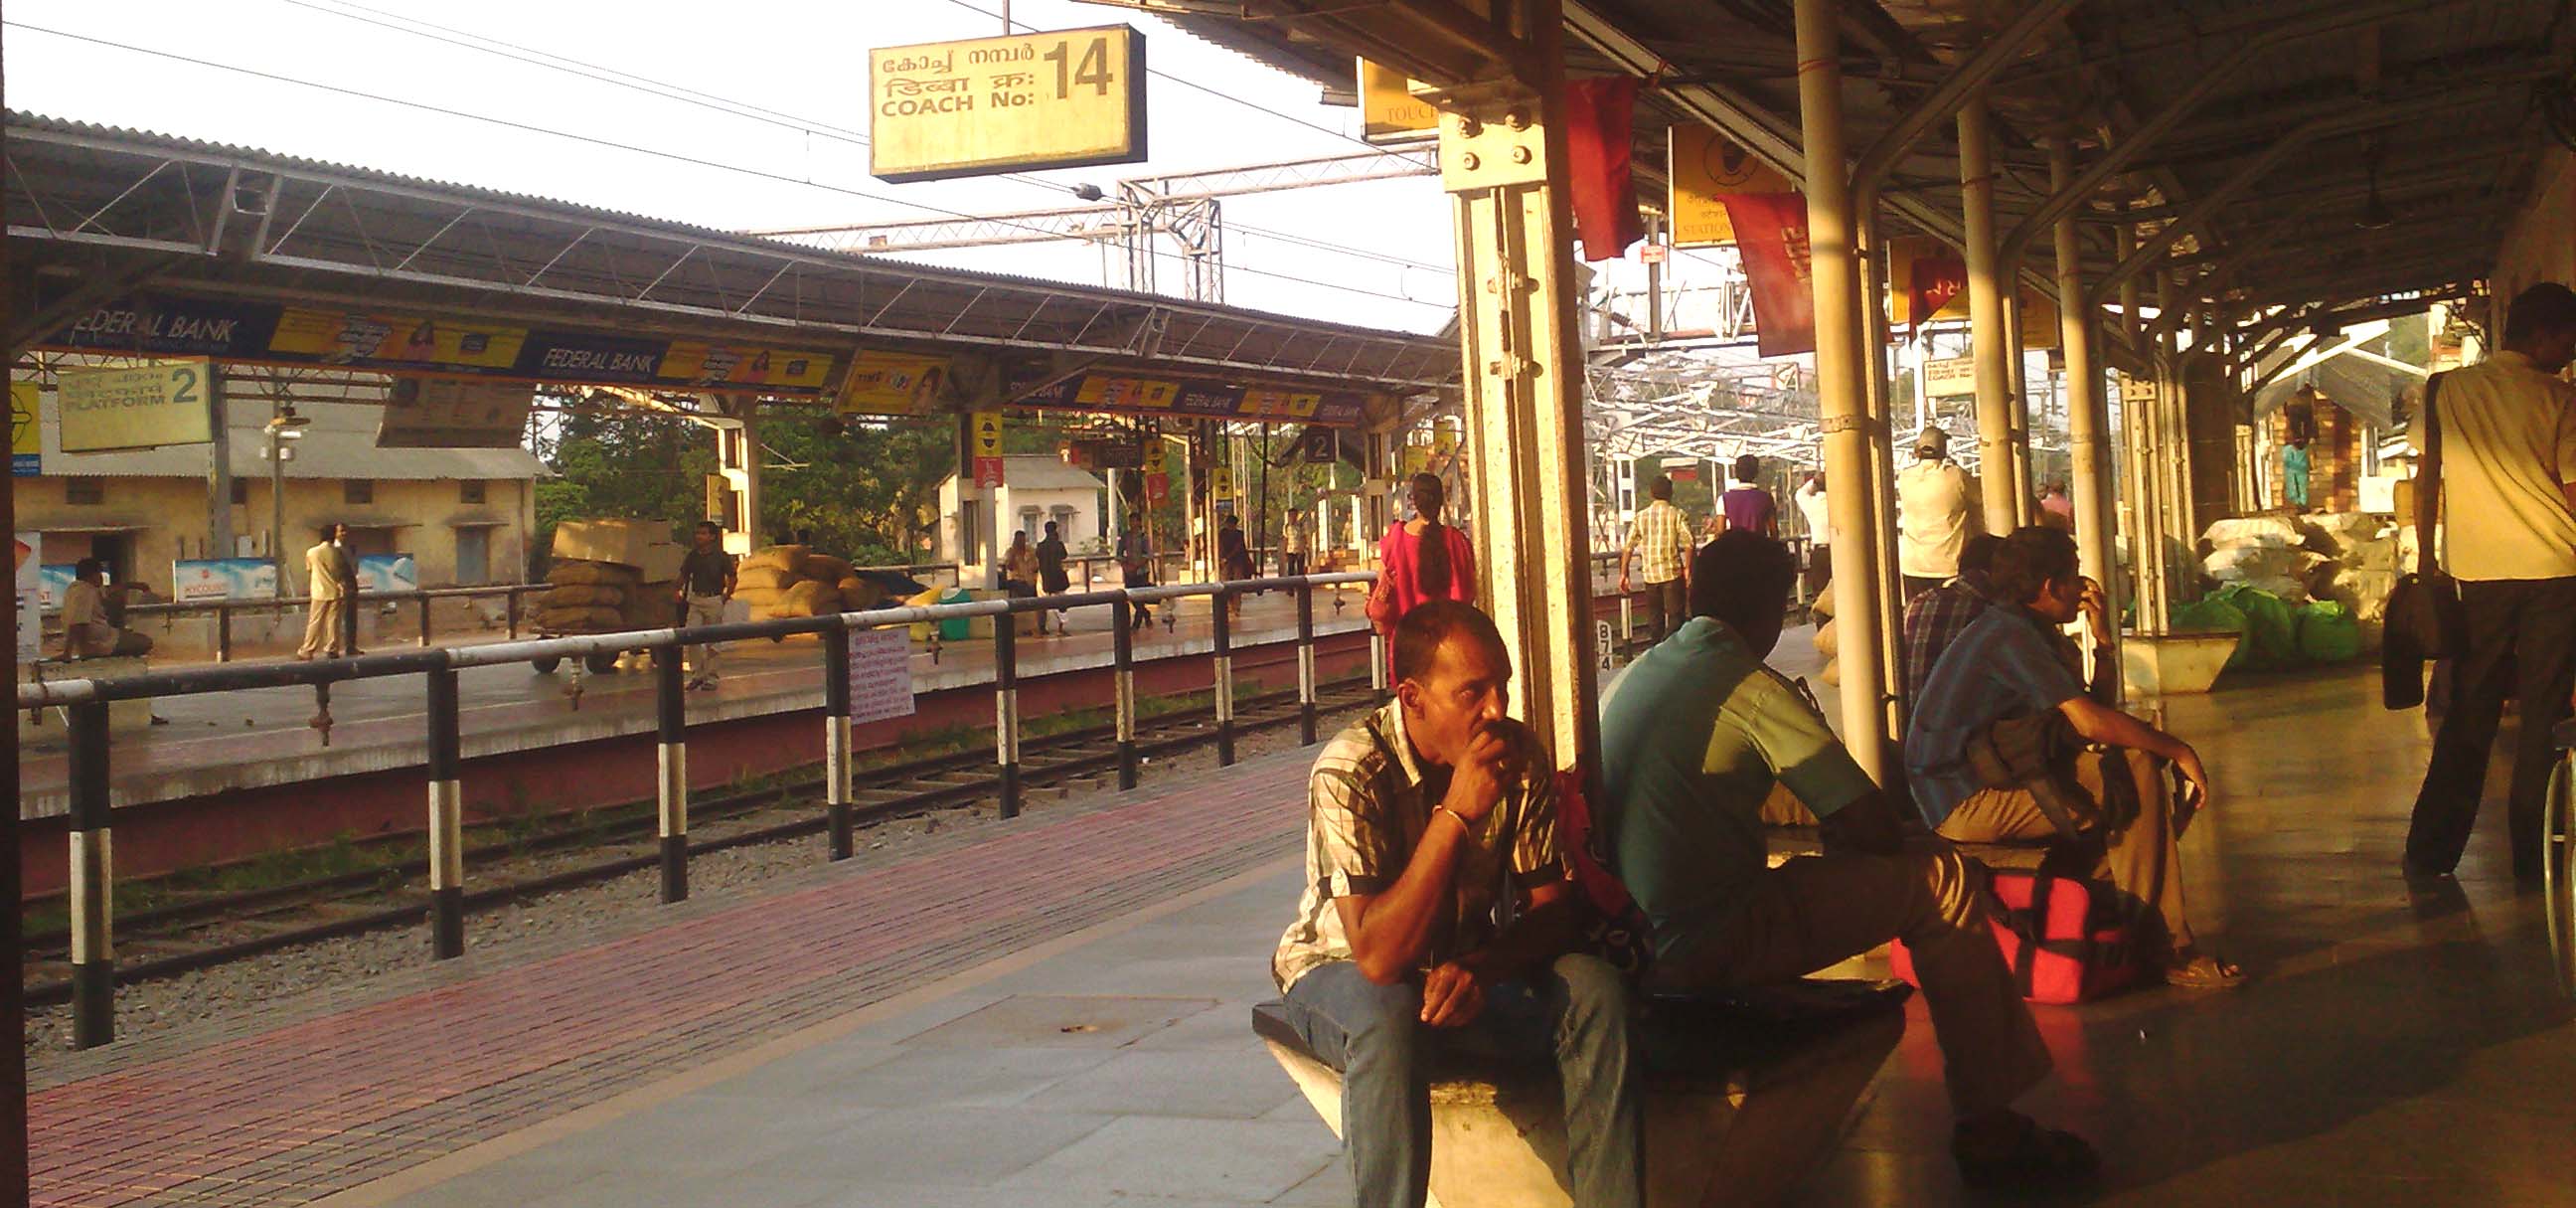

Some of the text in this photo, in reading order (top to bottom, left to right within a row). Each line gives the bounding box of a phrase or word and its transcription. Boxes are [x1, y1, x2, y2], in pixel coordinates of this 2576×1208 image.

[1043, 37, 1113, 100] 14
[885, 78, 970, 97] डिब्बा
[882, 91, 1035, 117] COACH No:
[167, 316, 239, 343] BANK
[543, 348, 657, 373] FEDERAL BANK
[172, 367, 198, 404] 2
[1314, 435, 1328, 458] 2
